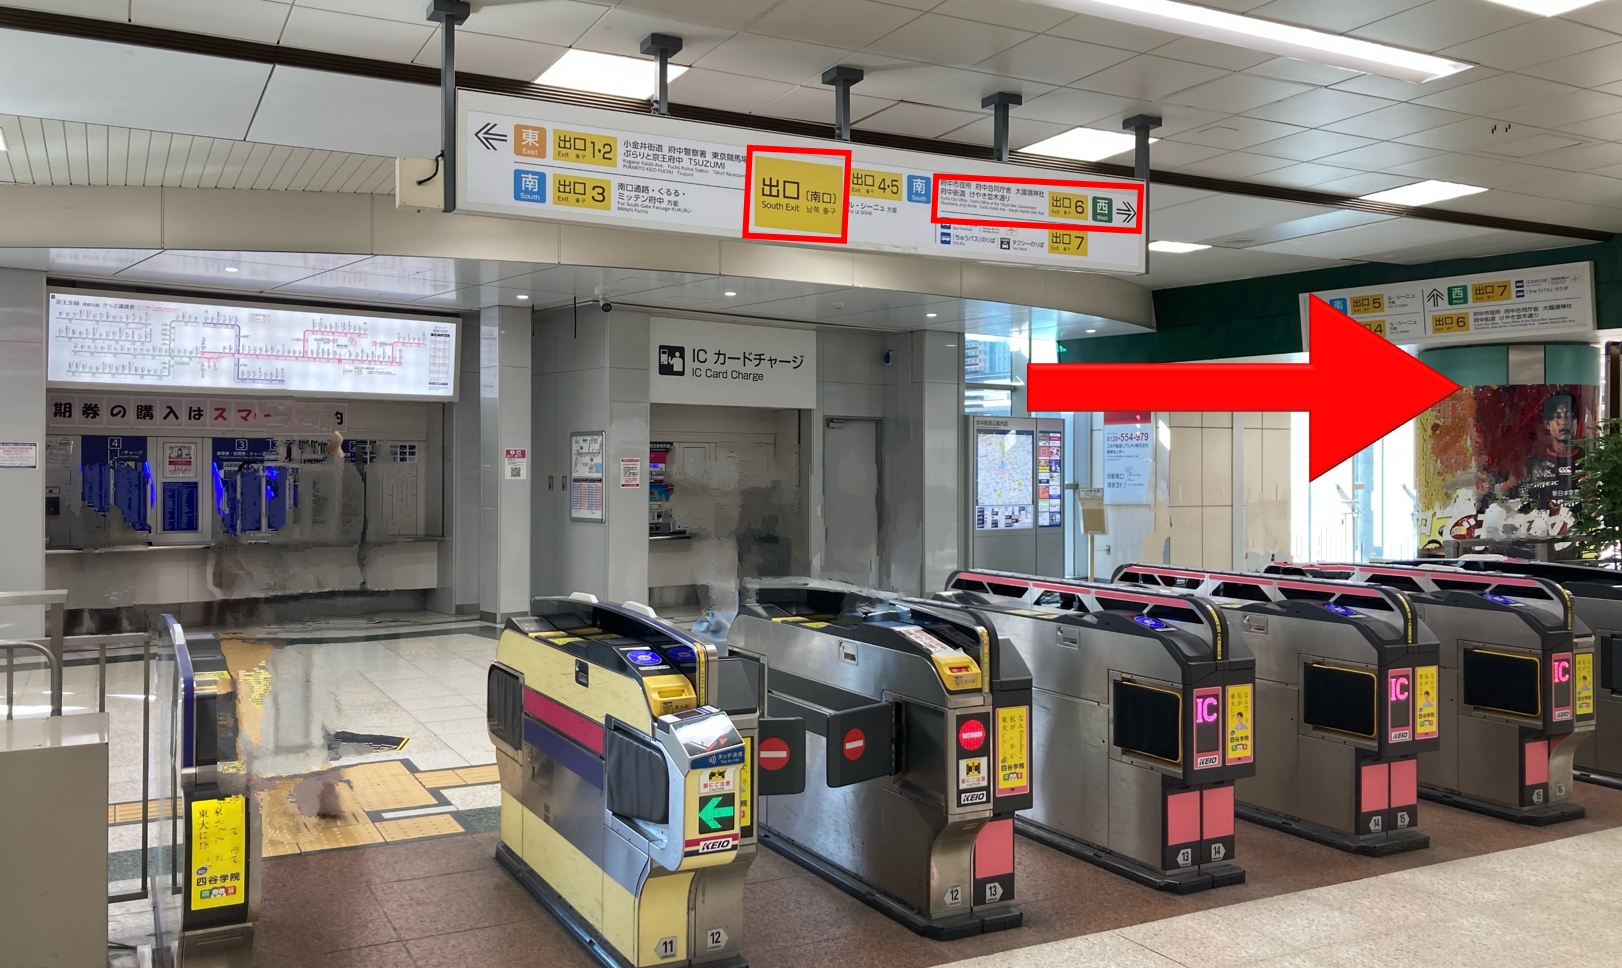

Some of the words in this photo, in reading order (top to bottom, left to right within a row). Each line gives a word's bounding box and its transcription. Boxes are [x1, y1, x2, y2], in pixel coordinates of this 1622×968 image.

[522, 128, 539, 146] 東
[558, 135, 586, 152] 出口
[623, 140, 663, 153] 小金井街道
[668, 146, 706, 158] 府中警察署
[522, 148, 538, 156] East
[623, 150, 683, 164] ぷらりと京王府中
[688, 158, 725, 169] TSUZUMI
[521, 174, 539, 192] 南
[852, 172, 875, 187] 出口
[558, 179, 586, 195] 出口
[591, 185, 605, 202] 3
[762, 177, 800, 200] 出口
[912, 178, 926, 194] 南
[941, 180, 971, 189] 府中市役所
[975, 184, 1011, 194] 府中合同庁舎
[520, 192, 540, 200] South
[618, 192, 664, 204] ミッテン府中
[941, 188, 965, 198] 府中街道
[970, 191, 1010, 202] けやき並木通り
[762, 201, 784, 211] South
[786, 204, 800, 212] Exit
[1052, 196, 1071, 208] 出口
[1075, 200, 1084, 214] 6
[1097, 199, 1108, 214] 西
[1012, 240, 1044, 248] タクシーのりば
[1052, 232, 1071, 245] 出口
[1074, 236, 1084, 250] 7
[1452, 287, 1463, 298] 西
[1475, 285, 1494, 295] 出口
[1497, 285, 1507, 296] 7
[1353, 298, 1369, 308] 出口
[1372, 298, 1381, 308] 5
[1435, 316, 1453, 326] 出口
[1456, 316, 1466, 328] 6
[1374, 324, 1383, 334] 4
[692, 349, 707, 363] IC
[714, 350, 804, 369] カードチャージ
[692, 368, 702, 377] IC
[705, 368, 728, 378] Card
[731, 370, 763, 381] Charge
[1554, 661, 1569, 682] IC
[1391, 678, 1408, 700] IC
[1196, 697, 1217, 722] IC
[1230, 735, 1249, 743] 四谷学院
[718, 752, 742, 760] タッチ決済
[1199, 757, 1217, 765] KEIO
[1001, 763, 1024, 771] 四谷学院
[963, 793, 985, 802] KEIO
[1536, 791, 1541, 799] 15
[1374, 818, 1379, 828] 14
[1400, 814, 1405, 824] 15
[702, 839, 730, 851] KEIO
[1214, 846, 1220, 856] 14
[1182, 851, 1189, 862] 13
[197, 873, 240, 886] 四谷学院
[950, 889, 959, 901] 12
[989, 885, 997, 897] 13
[710, 931, 721, 944] 12
[663, 940, 673, 953] 11
